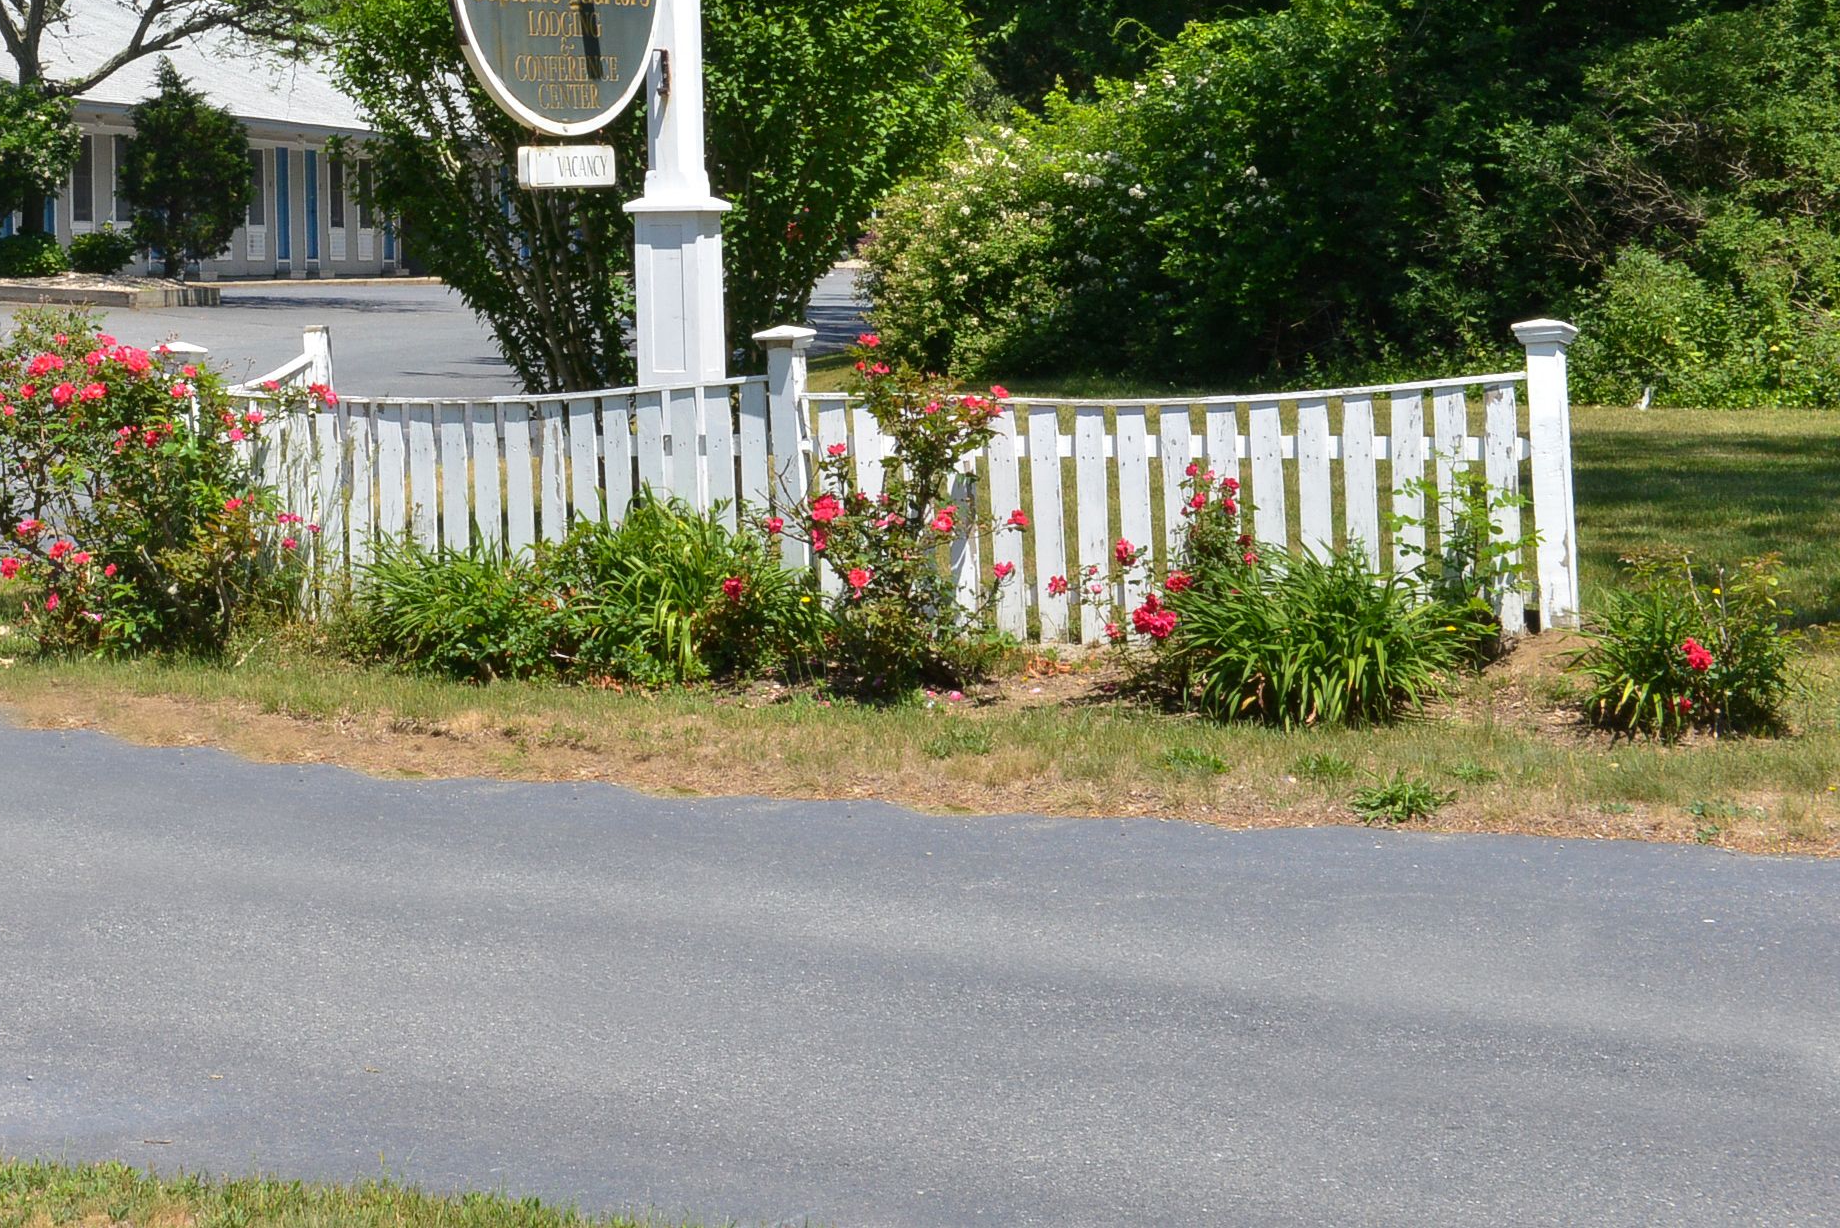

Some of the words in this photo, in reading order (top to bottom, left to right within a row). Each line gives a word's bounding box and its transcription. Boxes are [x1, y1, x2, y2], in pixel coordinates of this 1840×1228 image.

[528, 11, 602, 37] LODGING
[560, 37, 575, 55] &
[514, 54, 619, 82] CONFERENCE
[538, 84, 601, 110] CENTER
[557, 155, 608, 178] VACANCY
